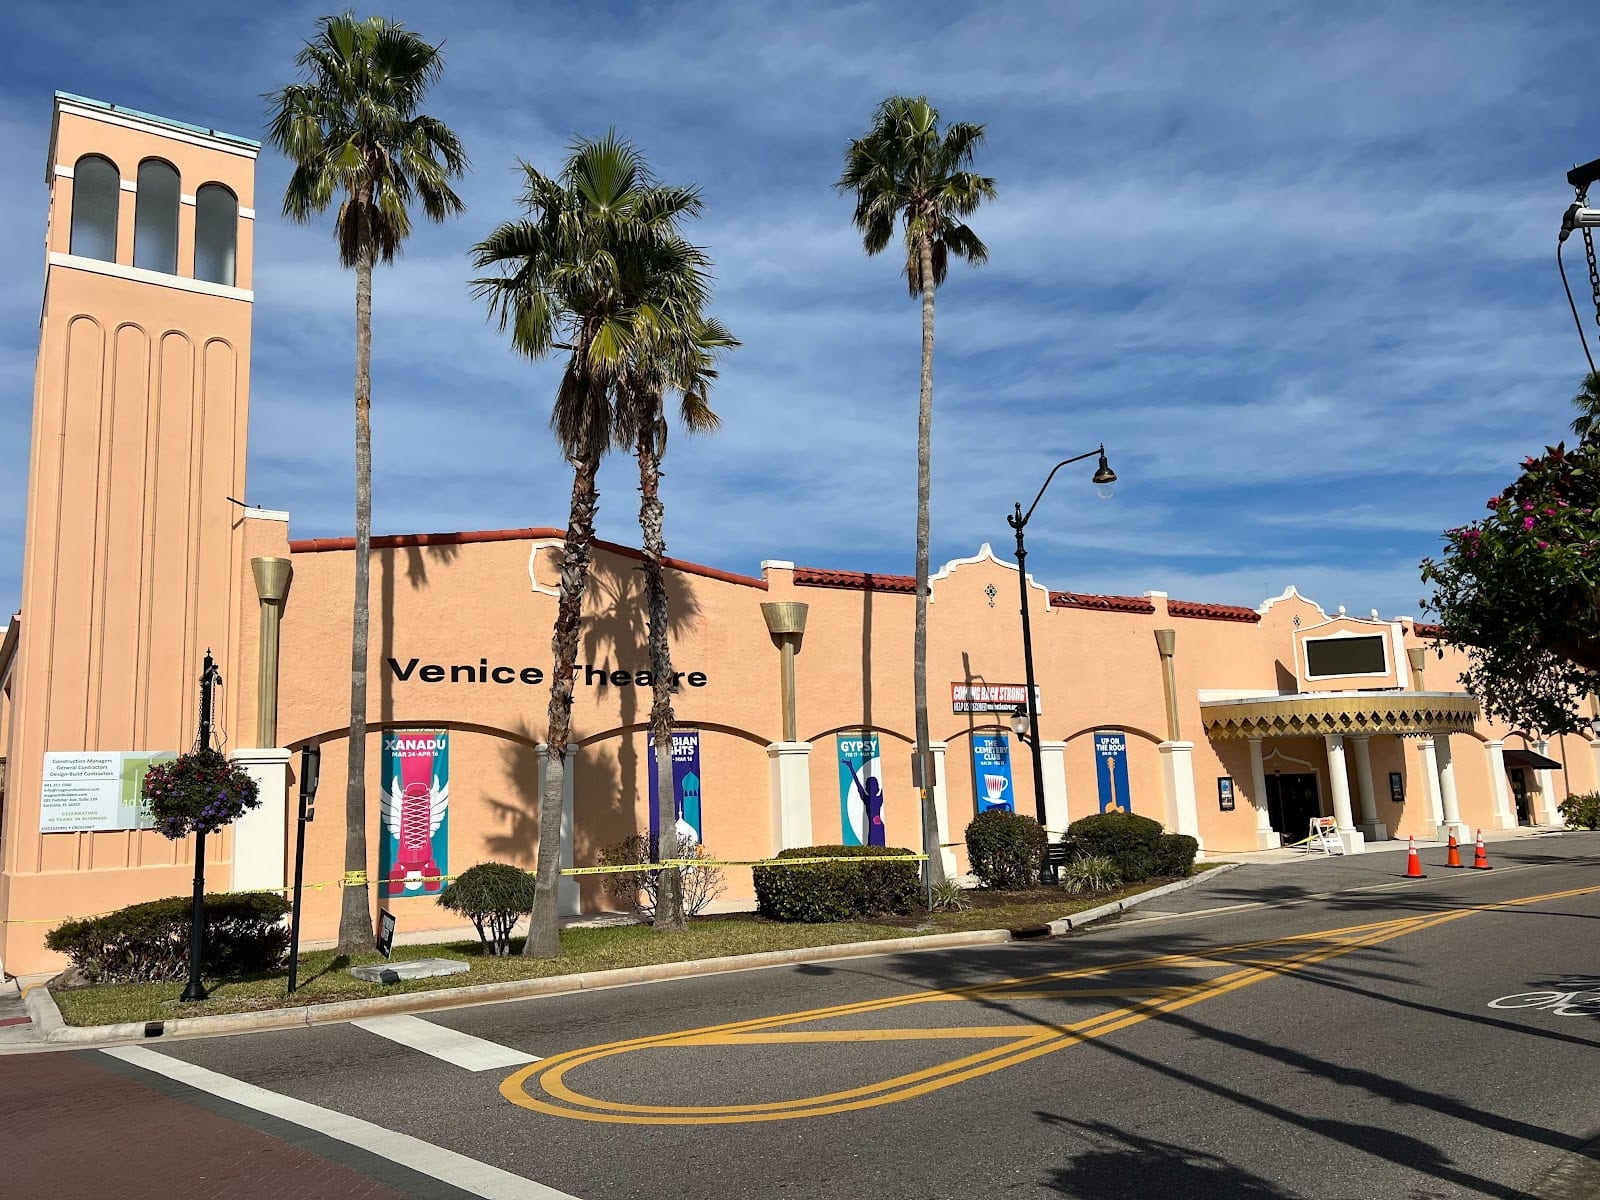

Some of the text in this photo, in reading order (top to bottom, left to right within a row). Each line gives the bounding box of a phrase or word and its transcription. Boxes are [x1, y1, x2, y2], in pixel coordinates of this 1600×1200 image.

[387, 658, 707, 687] Venice heare
[953, 686, 1025, 702] COMING BACK STRONG
[384, 739, 446, 750] XANADU
[840, 740, 877, 752] GYPSY
